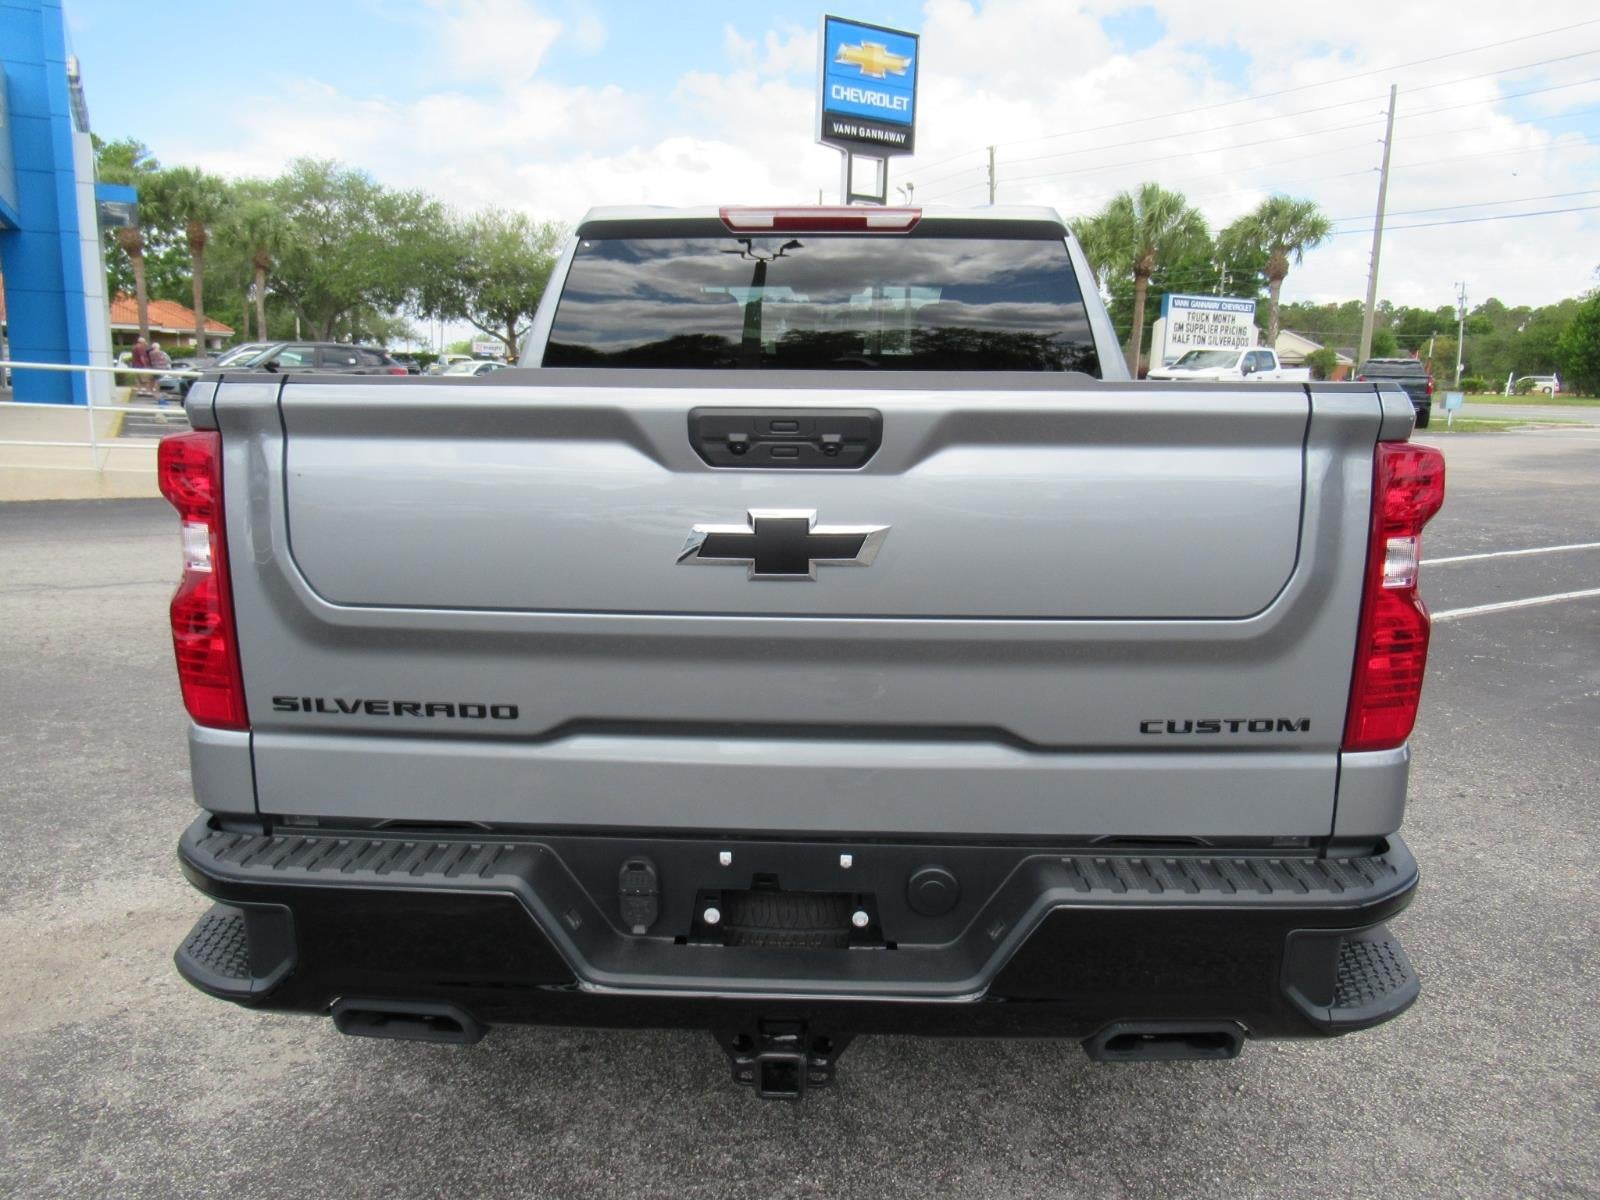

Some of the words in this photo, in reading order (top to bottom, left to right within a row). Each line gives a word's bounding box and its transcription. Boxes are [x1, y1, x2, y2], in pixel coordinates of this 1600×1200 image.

[831, 84, 909, 111] CHEVROLET
[833, 122, 857, 136] VANN
[859, 126, 906, 144] GANNAWAY
[1174, 298, 1190, 307] VANN
[1190, 300, 1220, 310] GANNAWAY
[1221, 302, 1253, 312] CHEVROLET
[1187, 312, 1210, 322] TRUCK
[1212, 313, 1236, 324] MONTH
[1173, 323, 1184, 332] GM
[1185, 323, 1218, 334] SUPPLIER
[1220, 325, 1247, 336] PRICING
[1172, 333, 1190, 344] HALF
[1192, 335, 1206, 345] TON
[1208, 336, 1249, 347] SILVERADOS
[272, 696, 519, 720] SILVERADO
[1139, 717, 1311, 734] CUSTOM
